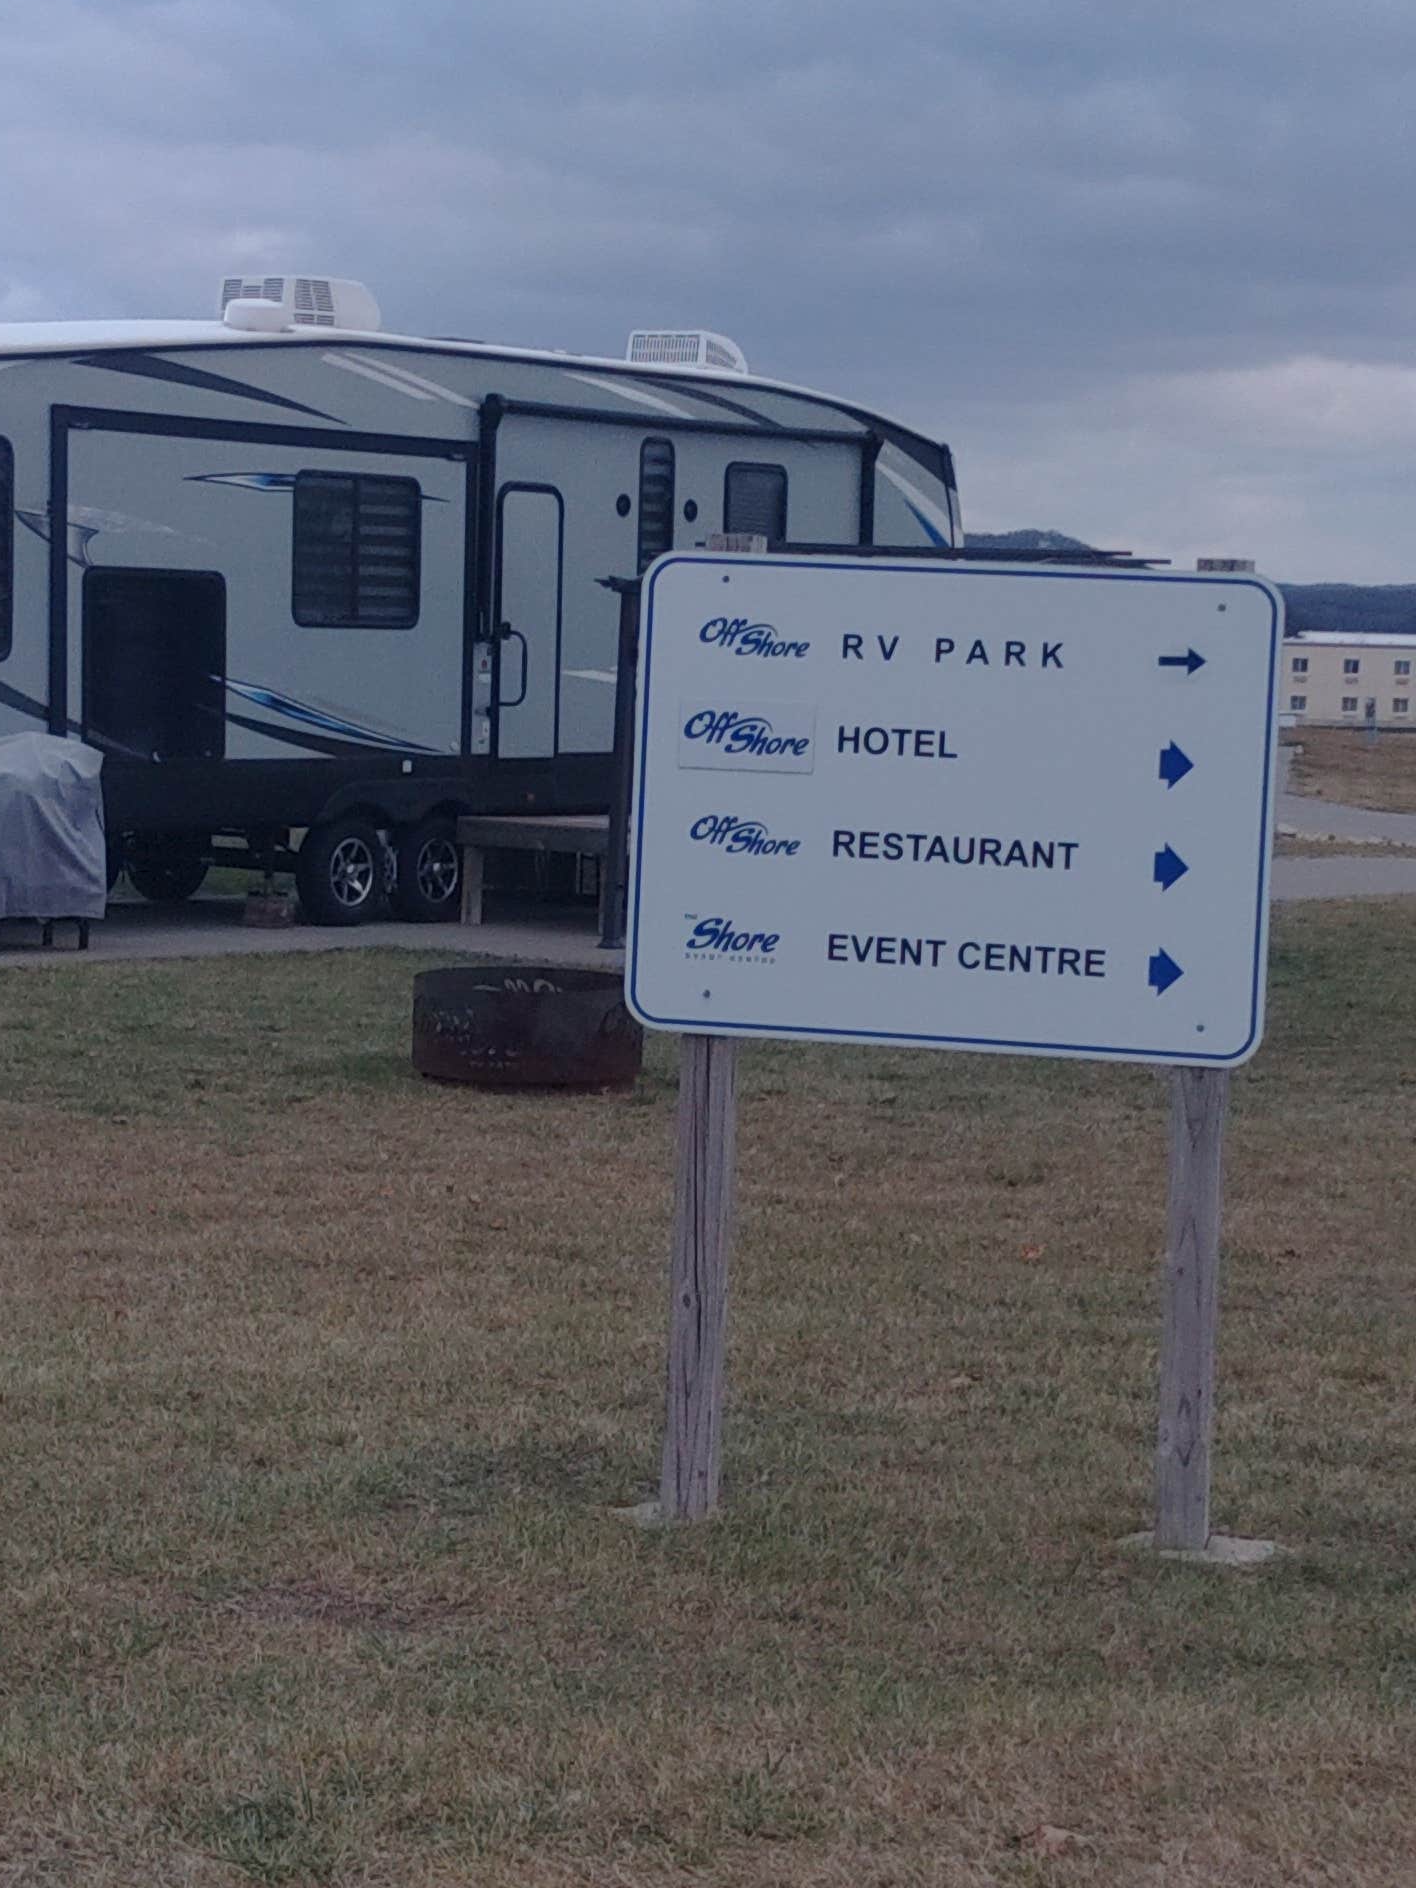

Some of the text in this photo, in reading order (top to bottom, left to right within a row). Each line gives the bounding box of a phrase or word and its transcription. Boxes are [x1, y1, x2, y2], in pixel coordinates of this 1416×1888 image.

[699, 617, 747, 647] Off
[735, 630, 811, 659] Shore
[684, 710, 958, 759] Off Shore HOTEL
[689, 814, 1080, 871] Off Shore RESTAURANT
[686, 917, 1107, 978] Shore EVENT CENTRE
